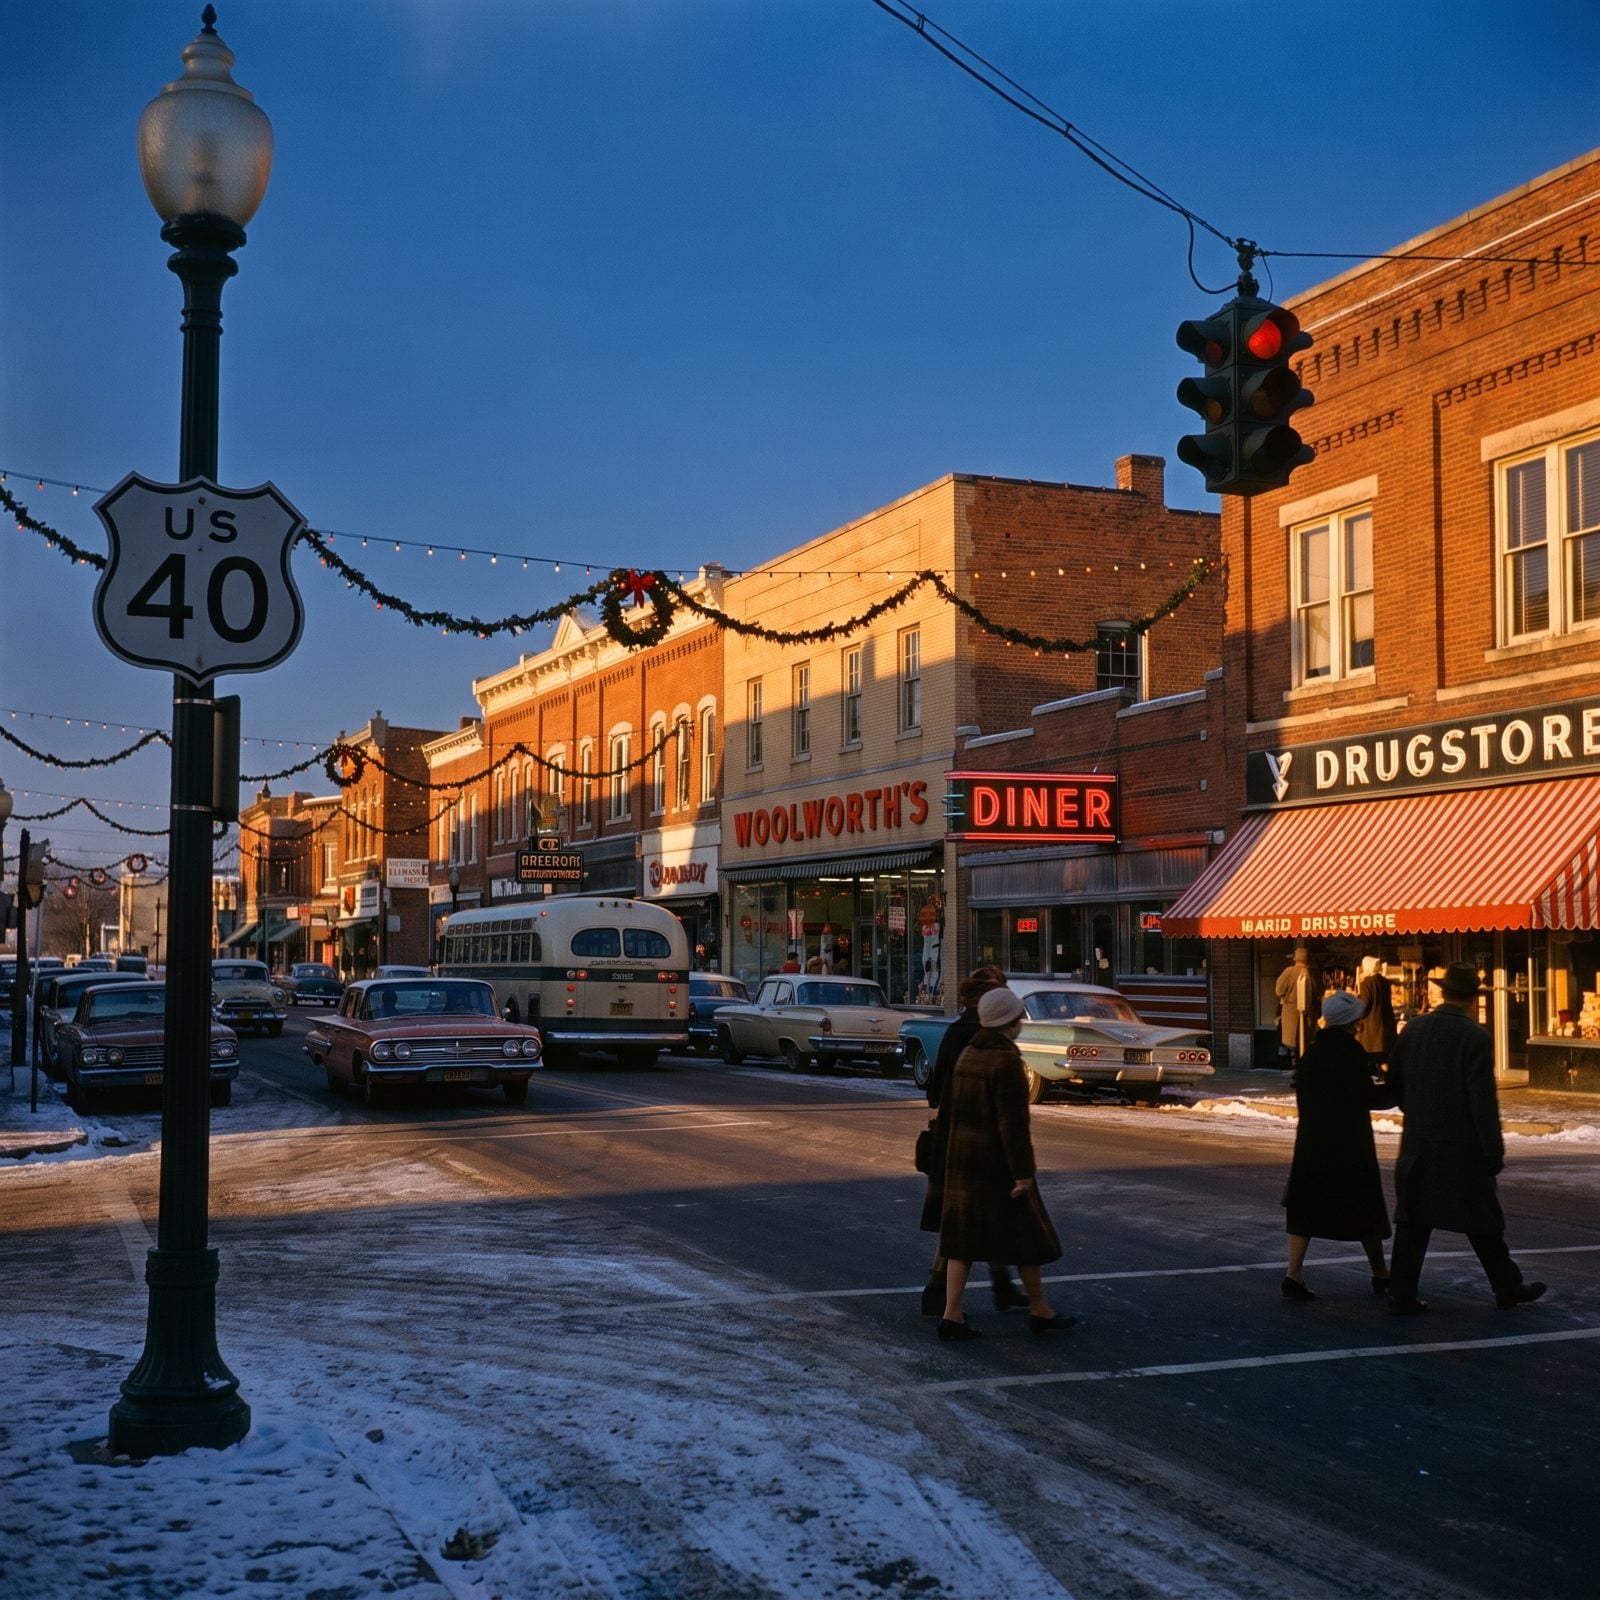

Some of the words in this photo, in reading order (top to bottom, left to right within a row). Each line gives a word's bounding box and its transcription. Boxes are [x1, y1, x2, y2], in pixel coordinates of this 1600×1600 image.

[165, 507, 238, 543] US
[127, 553, 268, 643] 40
[1316, 708, 1600, 789] DRUGSTORE
[734, 781, 929, 848] WOOLWORTH'S
[974, 787, 1111, 828] DINER
